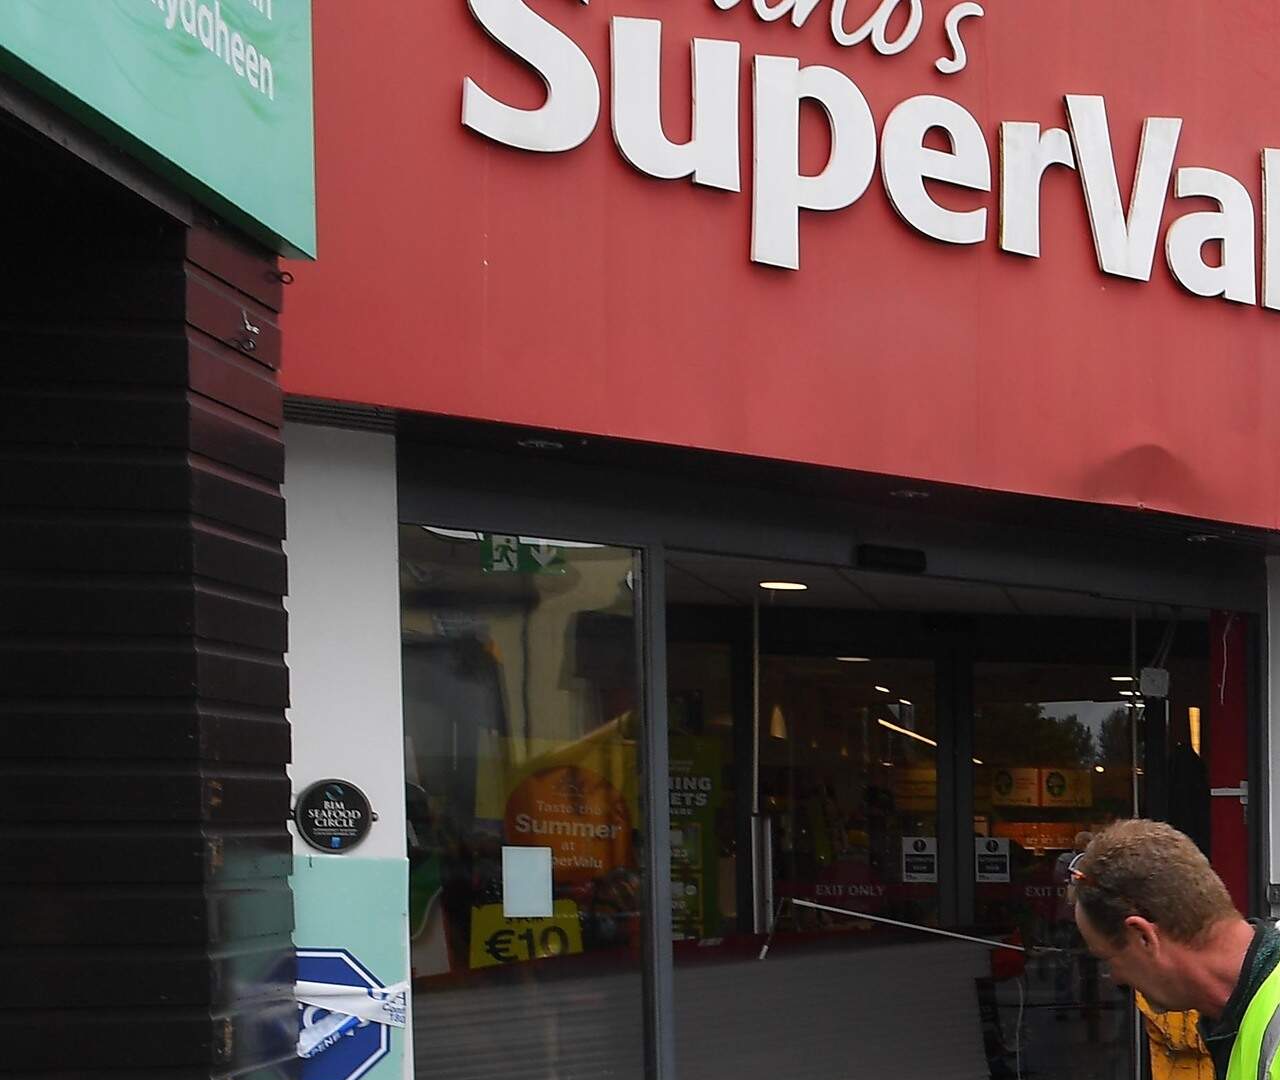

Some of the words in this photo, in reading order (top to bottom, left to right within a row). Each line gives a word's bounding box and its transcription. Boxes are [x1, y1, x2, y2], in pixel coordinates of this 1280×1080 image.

[323, 800, 345, 810] BIM
[537, 800, 572, 815] Taste
[307, 808, 362, 819] SEAFOOD
[313, 818, 356, 828] CIRCLE
[514, 813, 621, 840] Summer
[815, 884, 844, 897] EXIT
[848, 884, 887, 897] ONLY
[484, 925, 570, 963] €10
